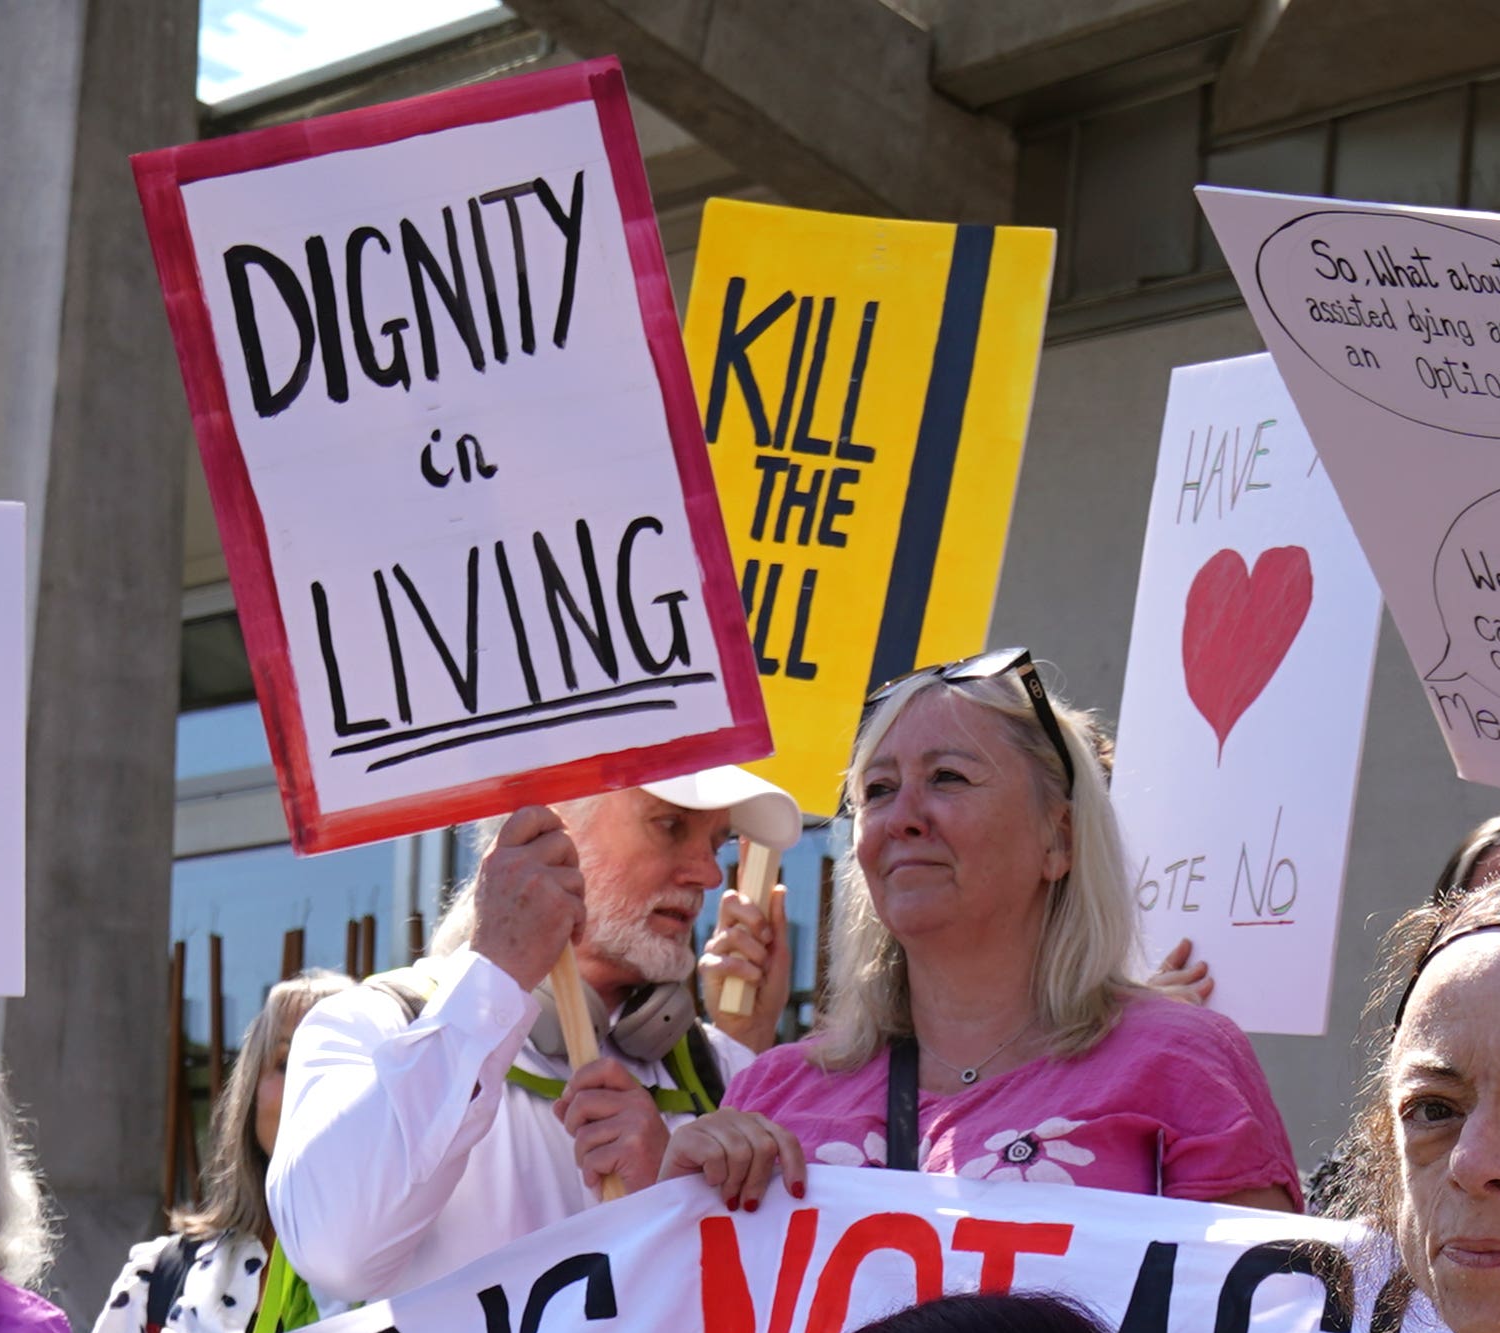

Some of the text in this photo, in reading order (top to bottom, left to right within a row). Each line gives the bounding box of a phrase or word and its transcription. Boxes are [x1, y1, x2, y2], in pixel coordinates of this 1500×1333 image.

[222, 170, 585, 418] DIGNITY
[1364, 244, 1439, 289] What
[705, 276, 880, 463] KILL
[1305, 294, 1398, 331] assisted
[1408, 300, 1476, 347] dying
[1346, 344, 1381, 368] an
[419, 428, 499, 489] in
[750, 455, 860, 548] THE
[1176, 418, 1279, 526] HAVE
[312, 515, 689, 738] LIVING
[740, 558, 819, 680] ILL
